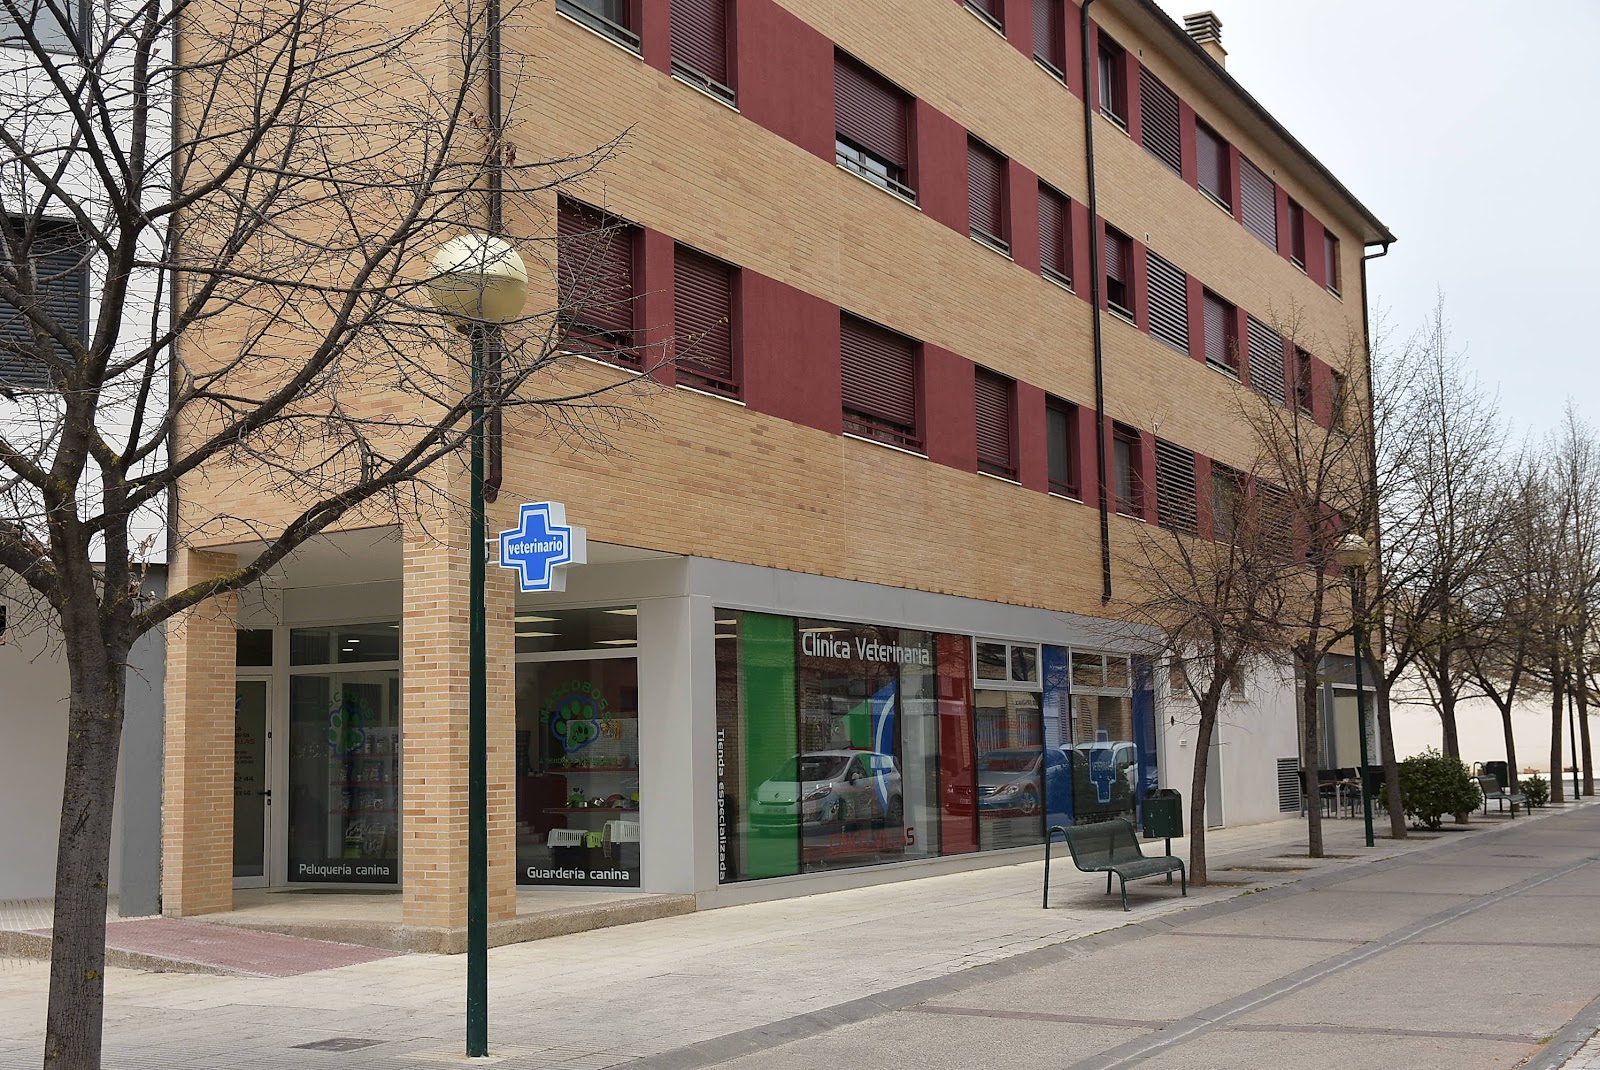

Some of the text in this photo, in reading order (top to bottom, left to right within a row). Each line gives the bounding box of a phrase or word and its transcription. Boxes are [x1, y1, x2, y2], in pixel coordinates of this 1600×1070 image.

[508, 536, 563, 555] veterinario
[801, 631, 930, 665] Clínica Veterinaria
[717, 728, 727, 881] Tienda especializada
[299, 863, 390, 877] Peluquería canina
[526, 866, 630, 880] Guardería canina
